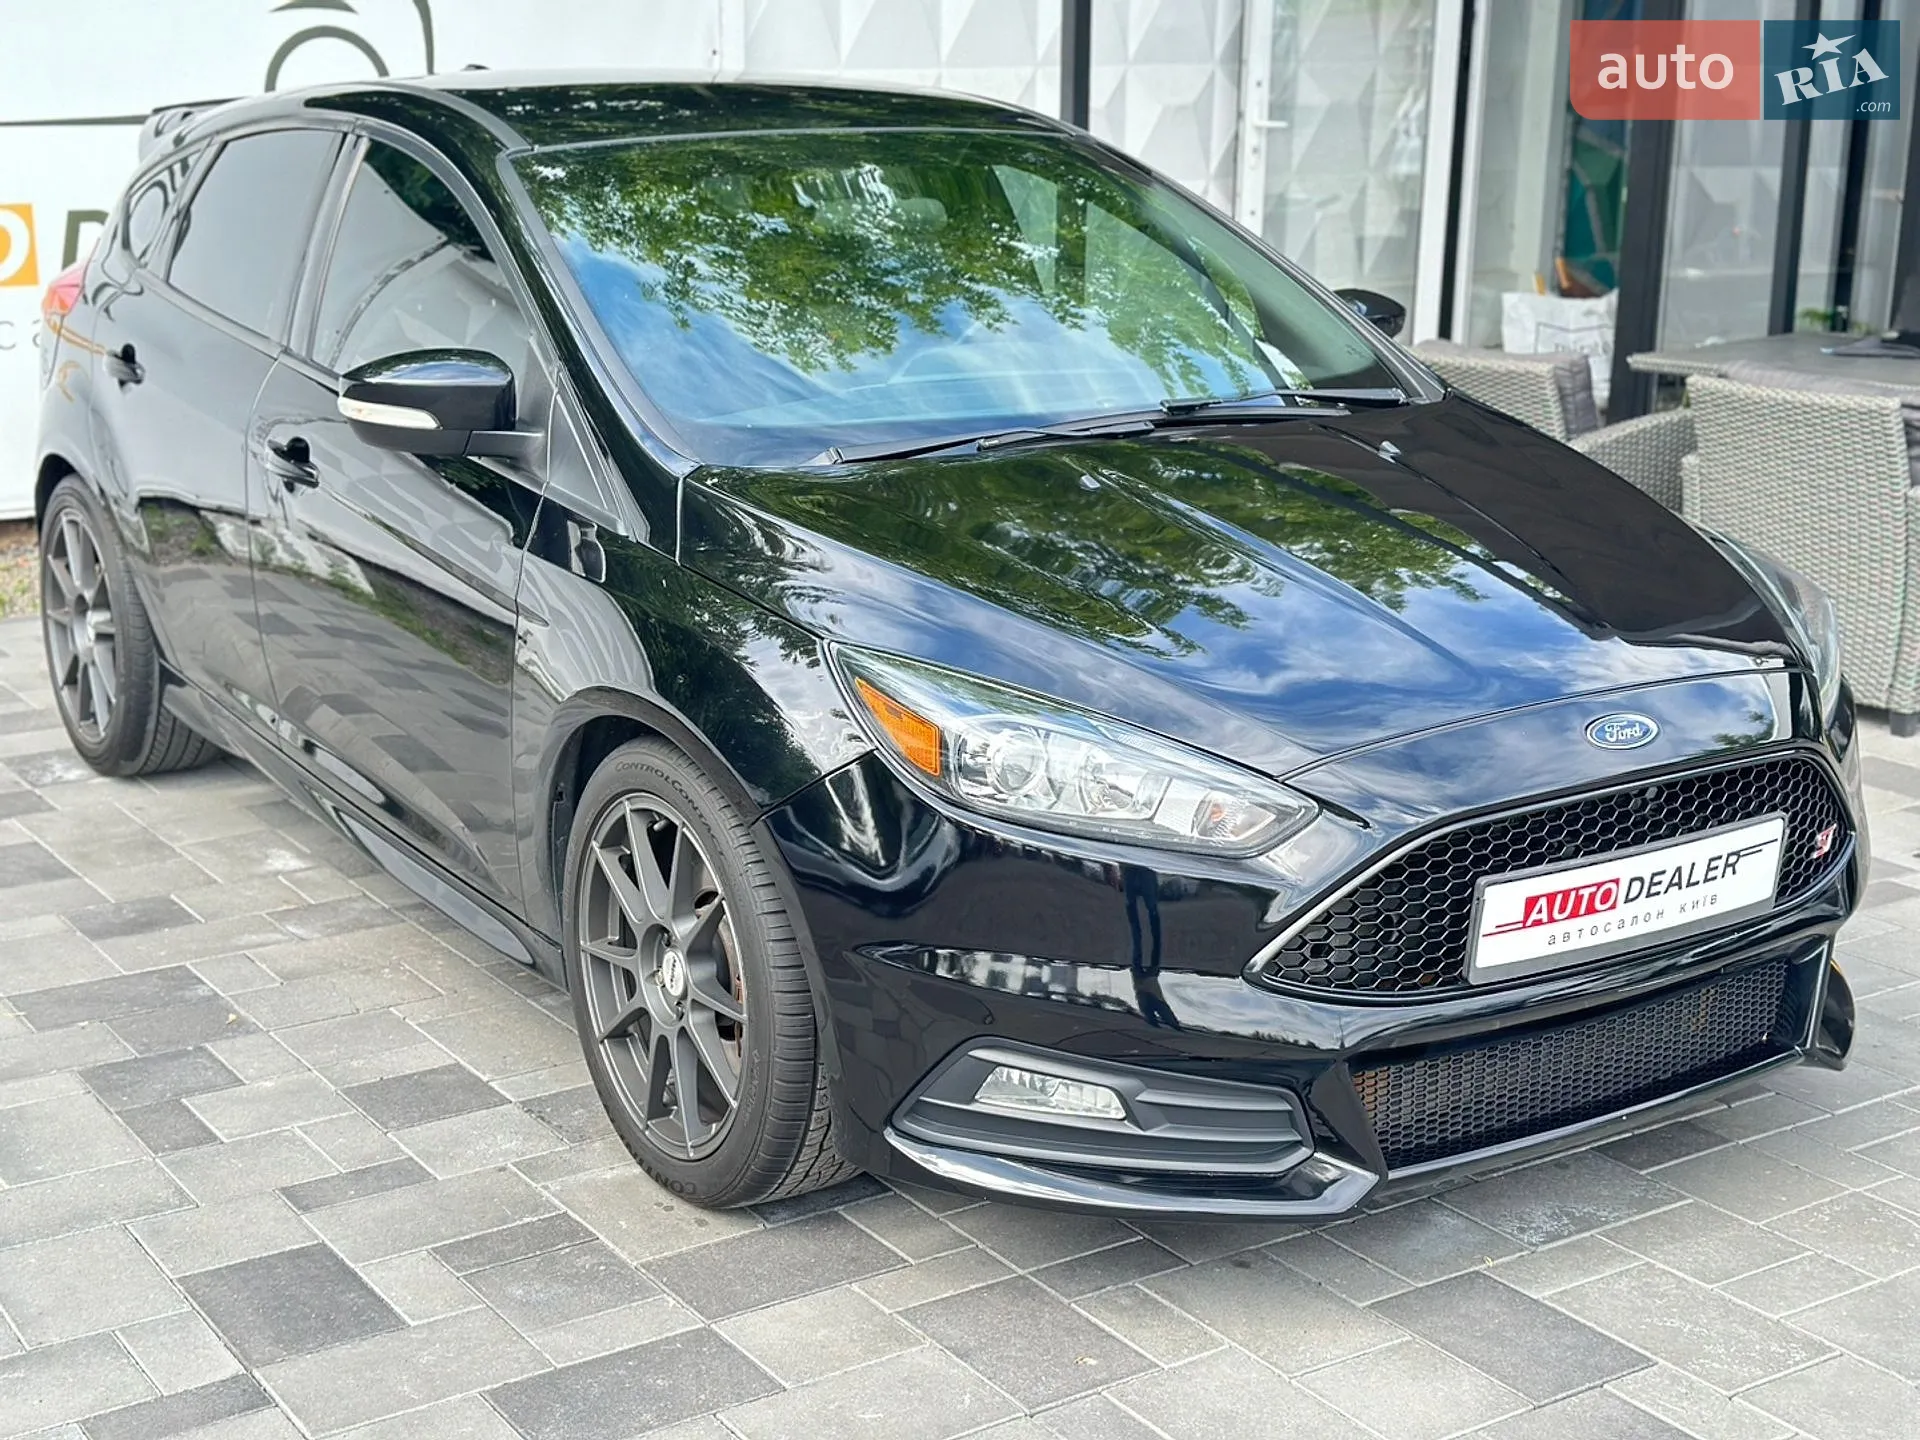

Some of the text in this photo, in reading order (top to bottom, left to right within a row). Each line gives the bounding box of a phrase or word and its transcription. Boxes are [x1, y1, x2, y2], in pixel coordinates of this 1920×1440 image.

[1604, 720, 1644, 743] Ford
[1526, 851, 1742, 928] AUTO DEALER
[1547, 909, 1665, 946] автосалон
